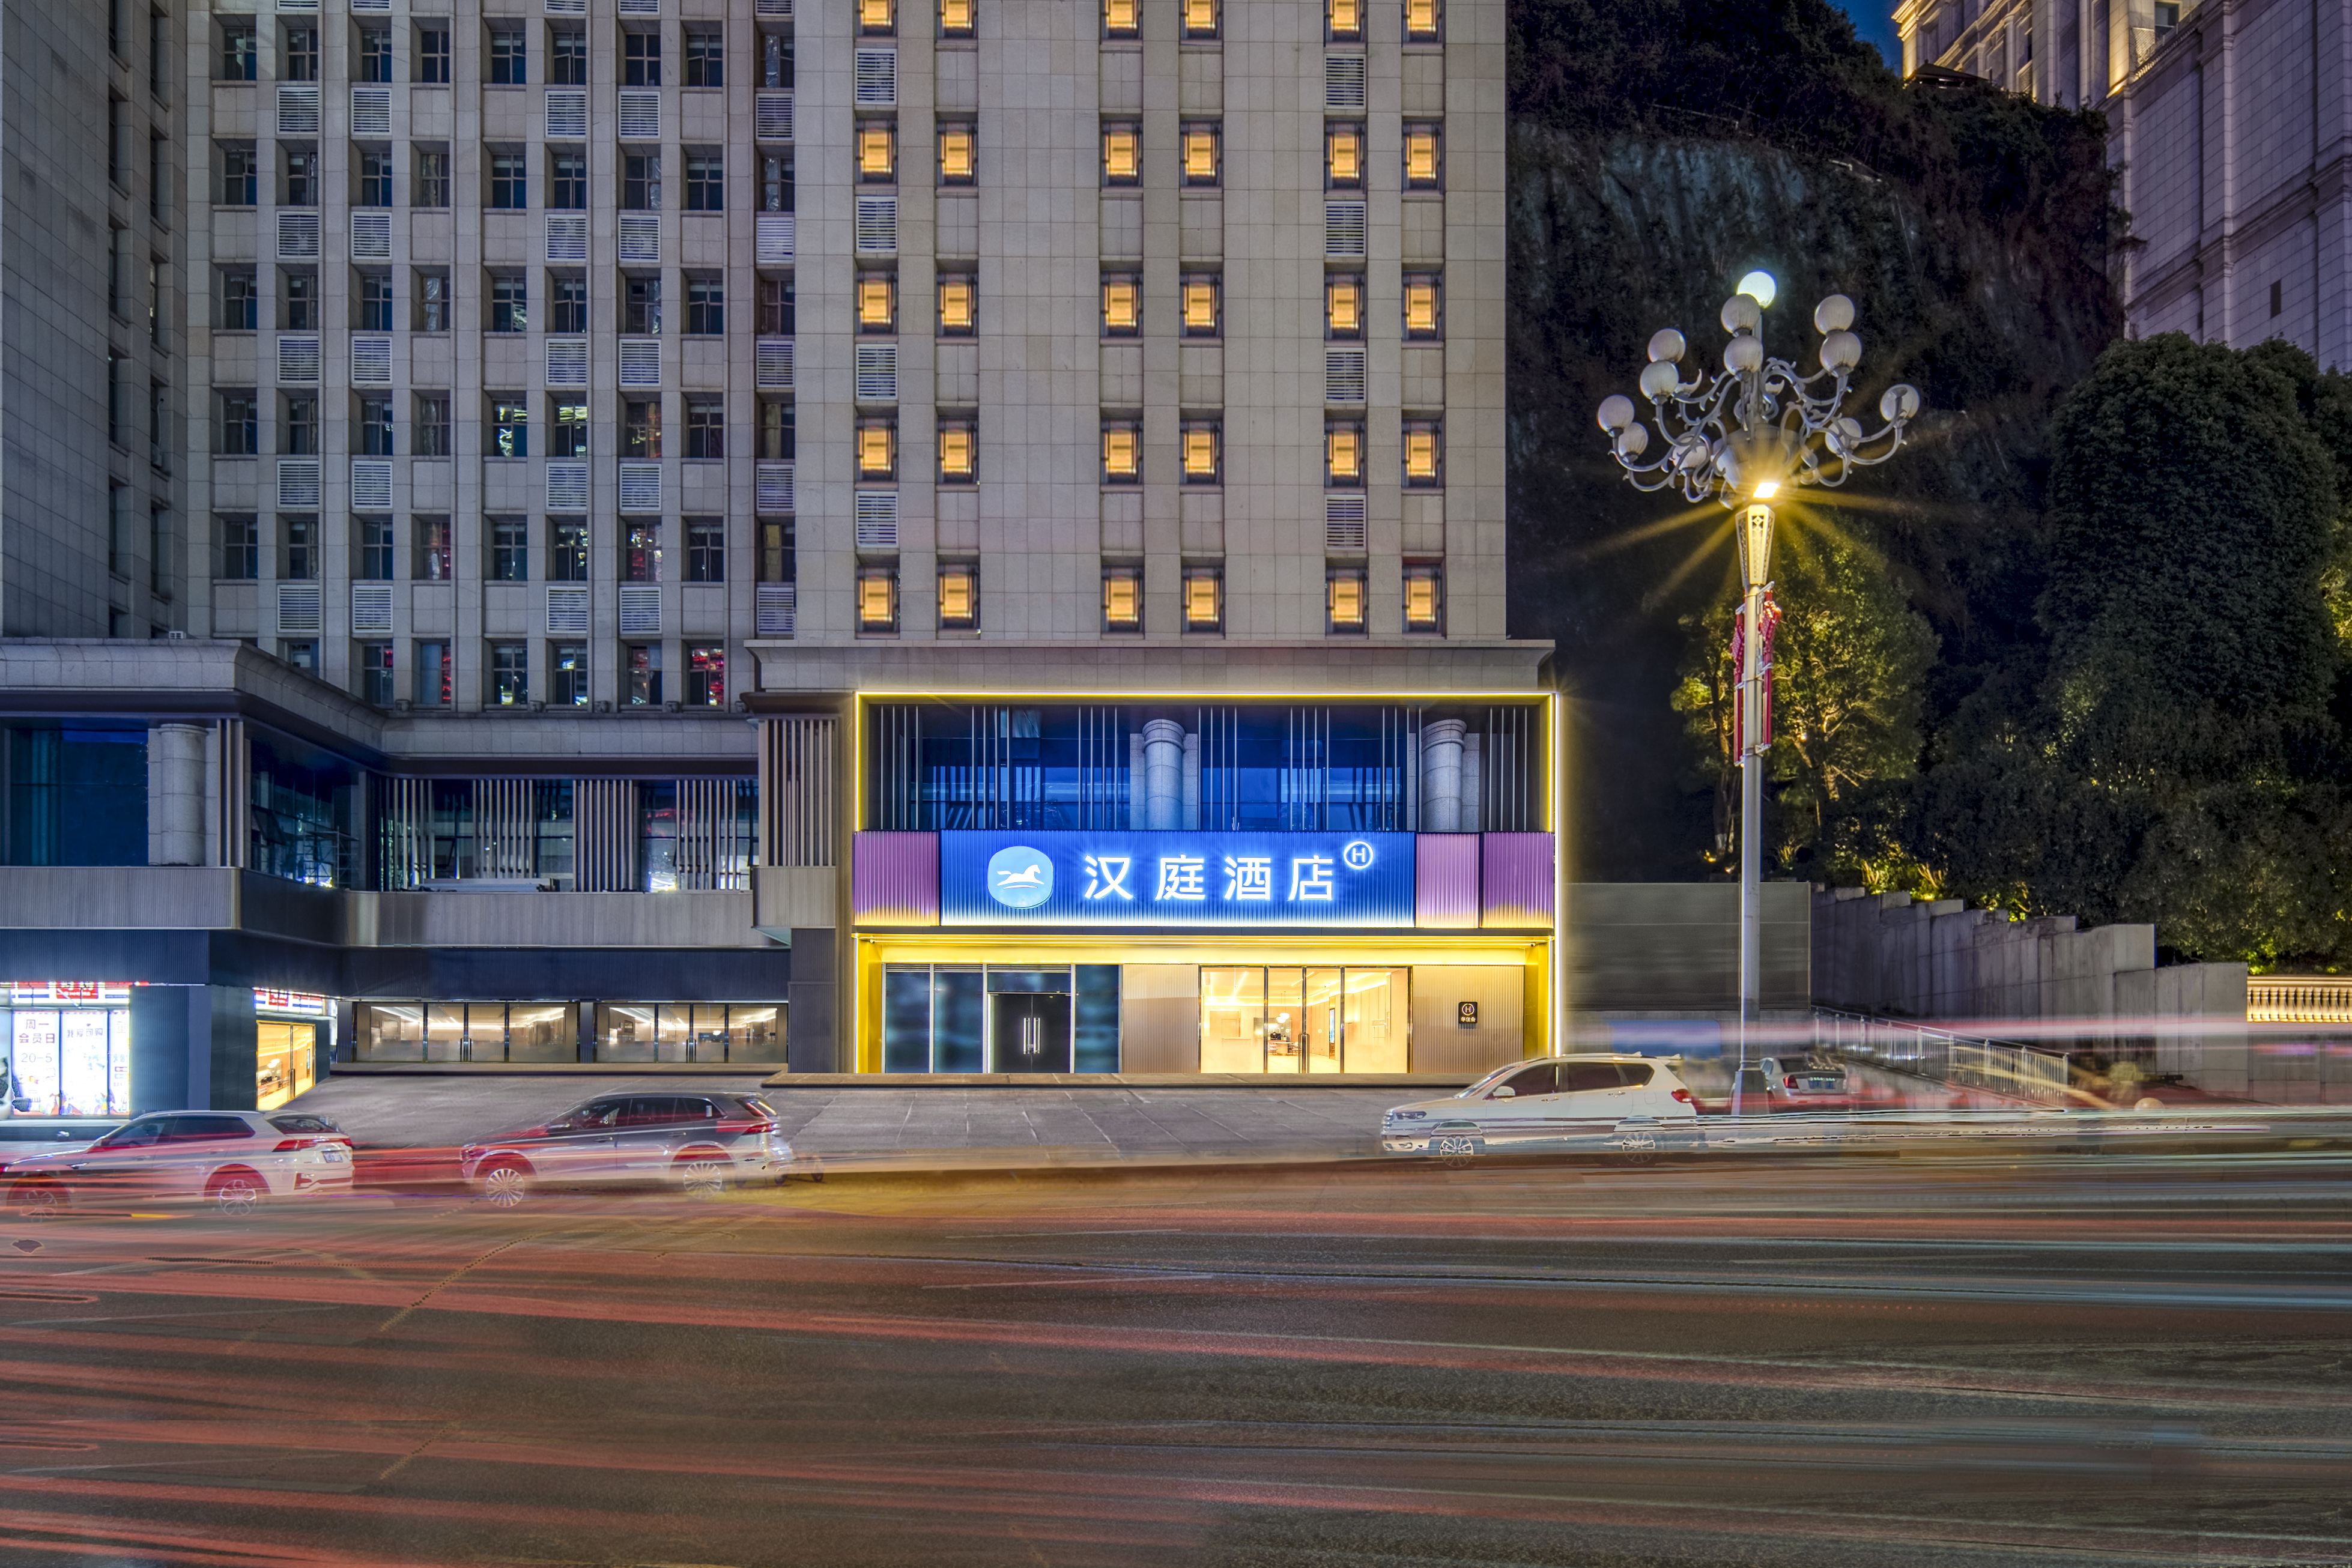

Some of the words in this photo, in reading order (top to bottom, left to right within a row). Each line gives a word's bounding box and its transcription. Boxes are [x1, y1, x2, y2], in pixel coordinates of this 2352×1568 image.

[1084, 853, 1333, 901] 汉庭酒店
[25, 1019, 49, 1030] 周一
[19, 1033, 55, 1044] 会员日
[21, 1052, 52, 1063] 20-5
